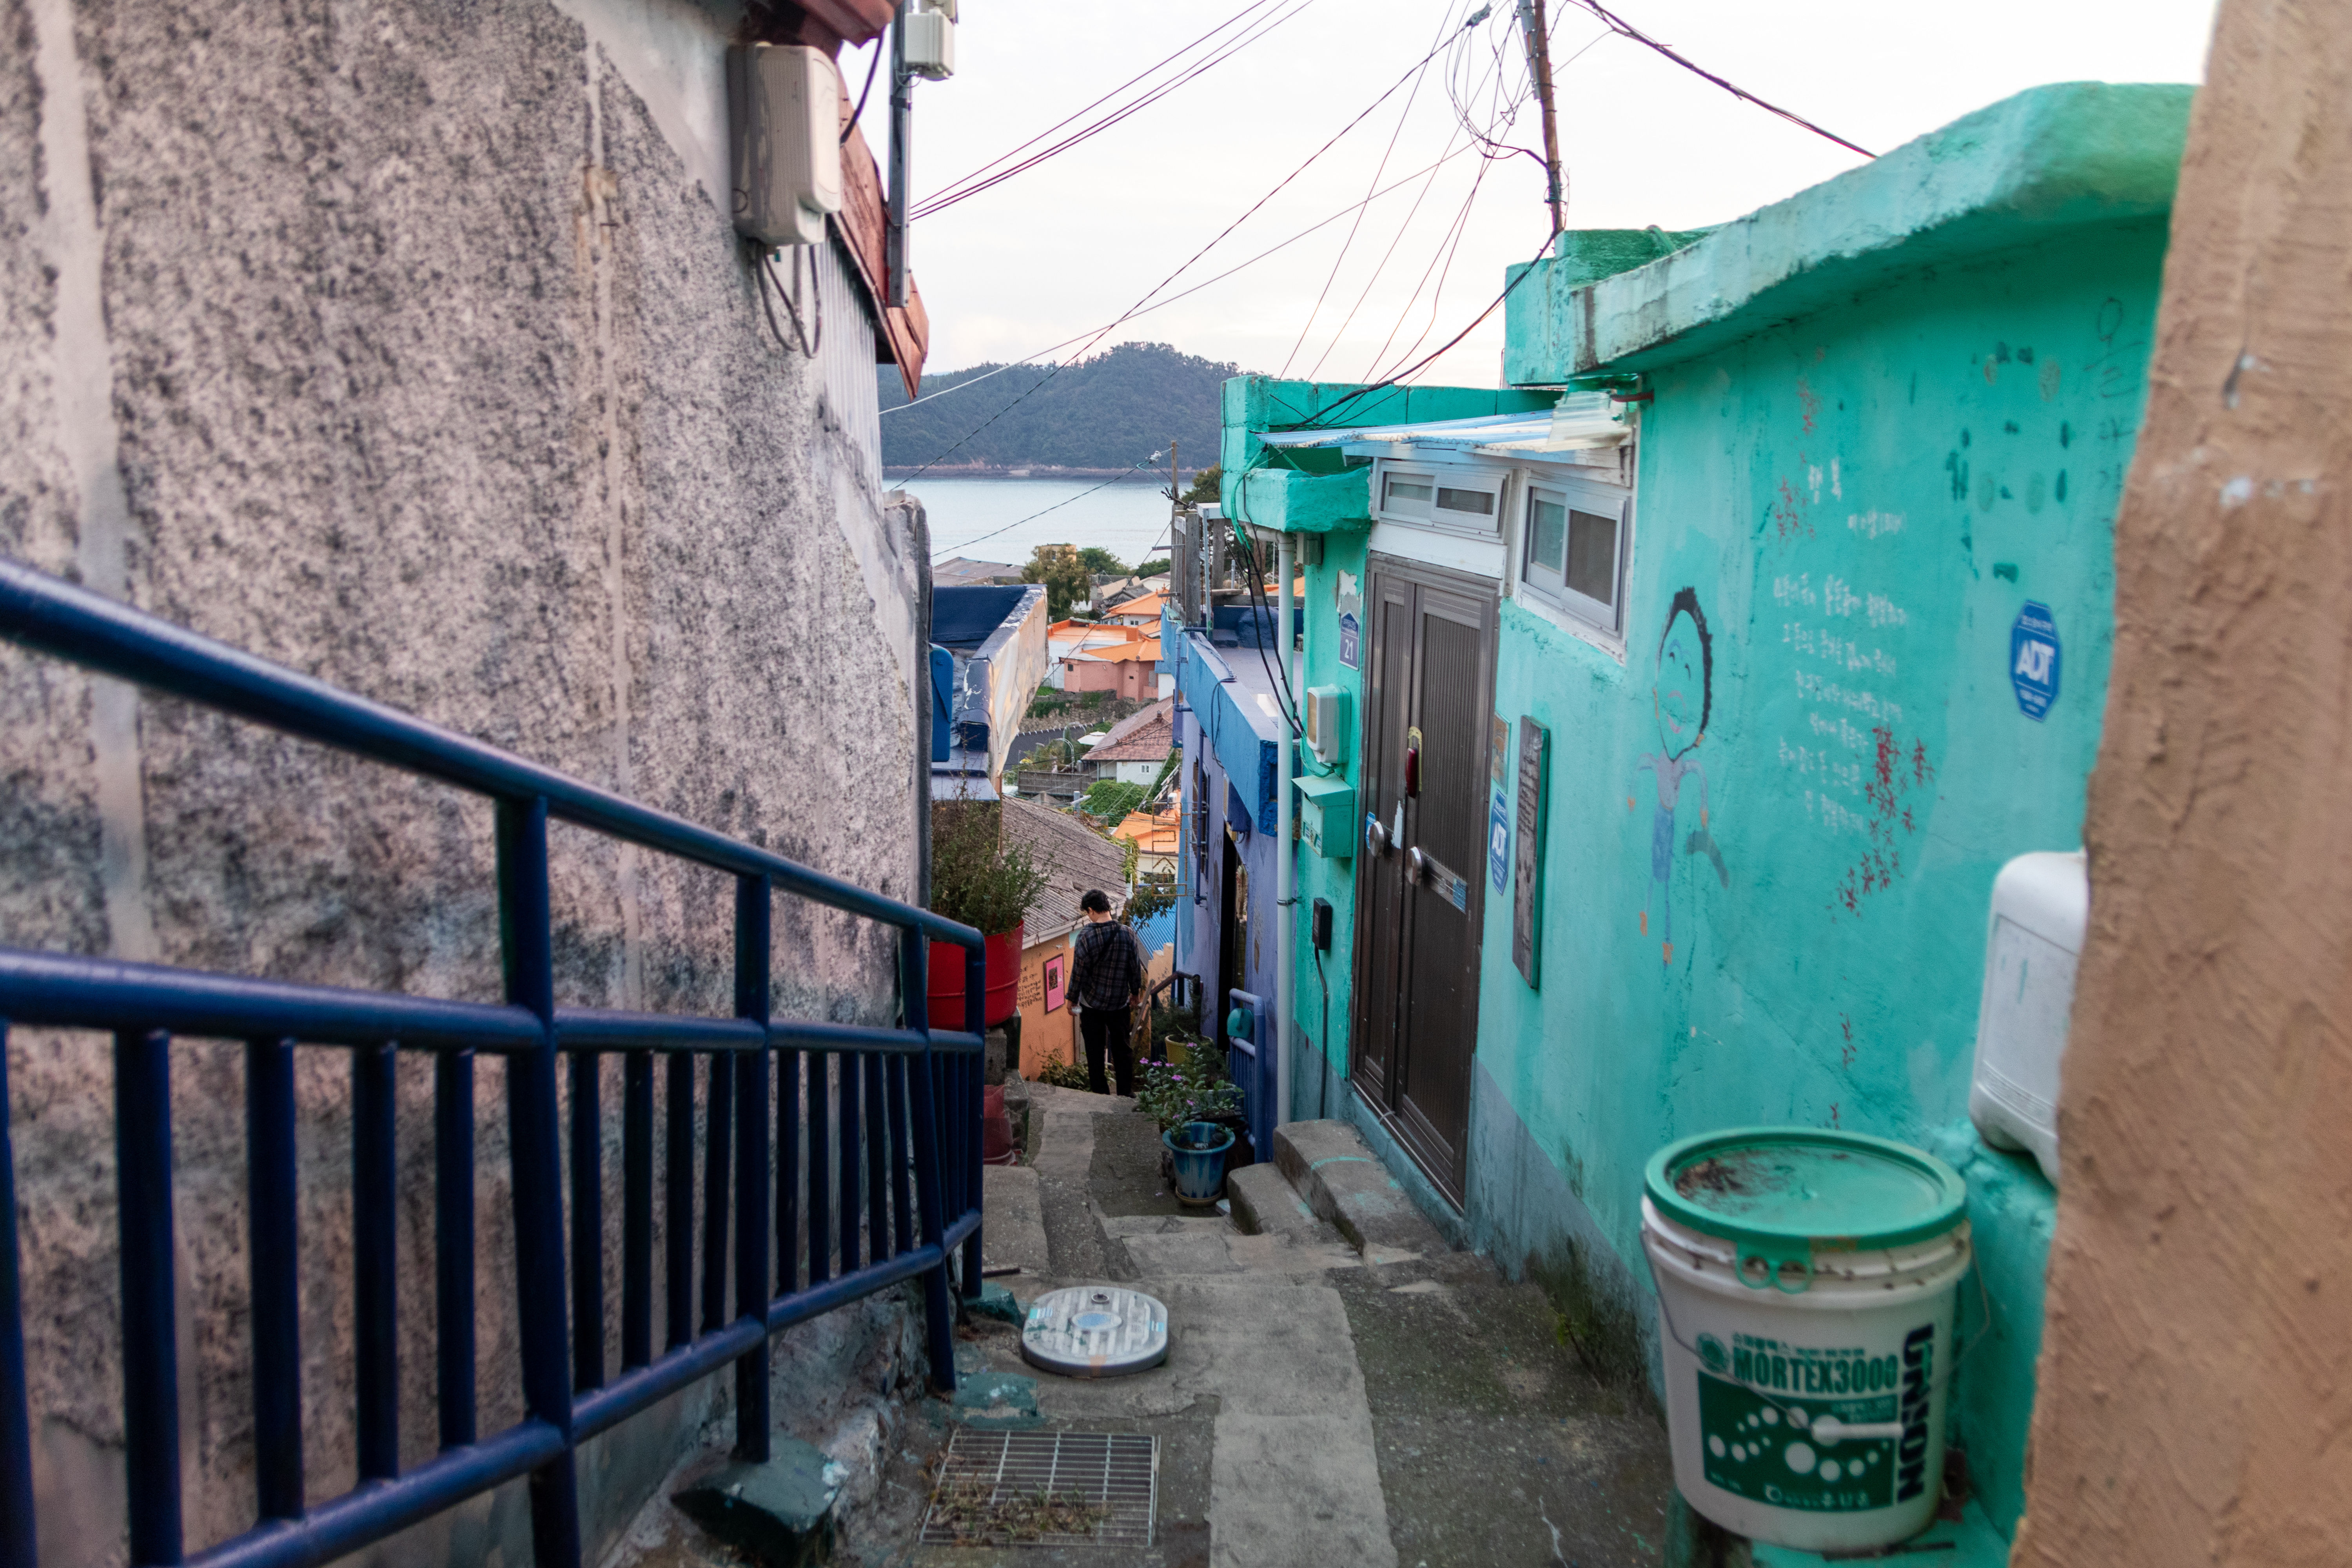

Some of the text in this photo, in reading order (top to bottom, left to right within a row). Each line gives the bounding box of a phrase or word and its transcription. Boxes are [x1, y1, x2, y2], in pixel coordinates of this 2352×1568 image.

[1345, 639, 1353, 660] 21
[2016, 639, 2056, 686] ADT
[1491, 821, 1507, 862] ADT
[1897, 1323, 1935, 1503] UNION
